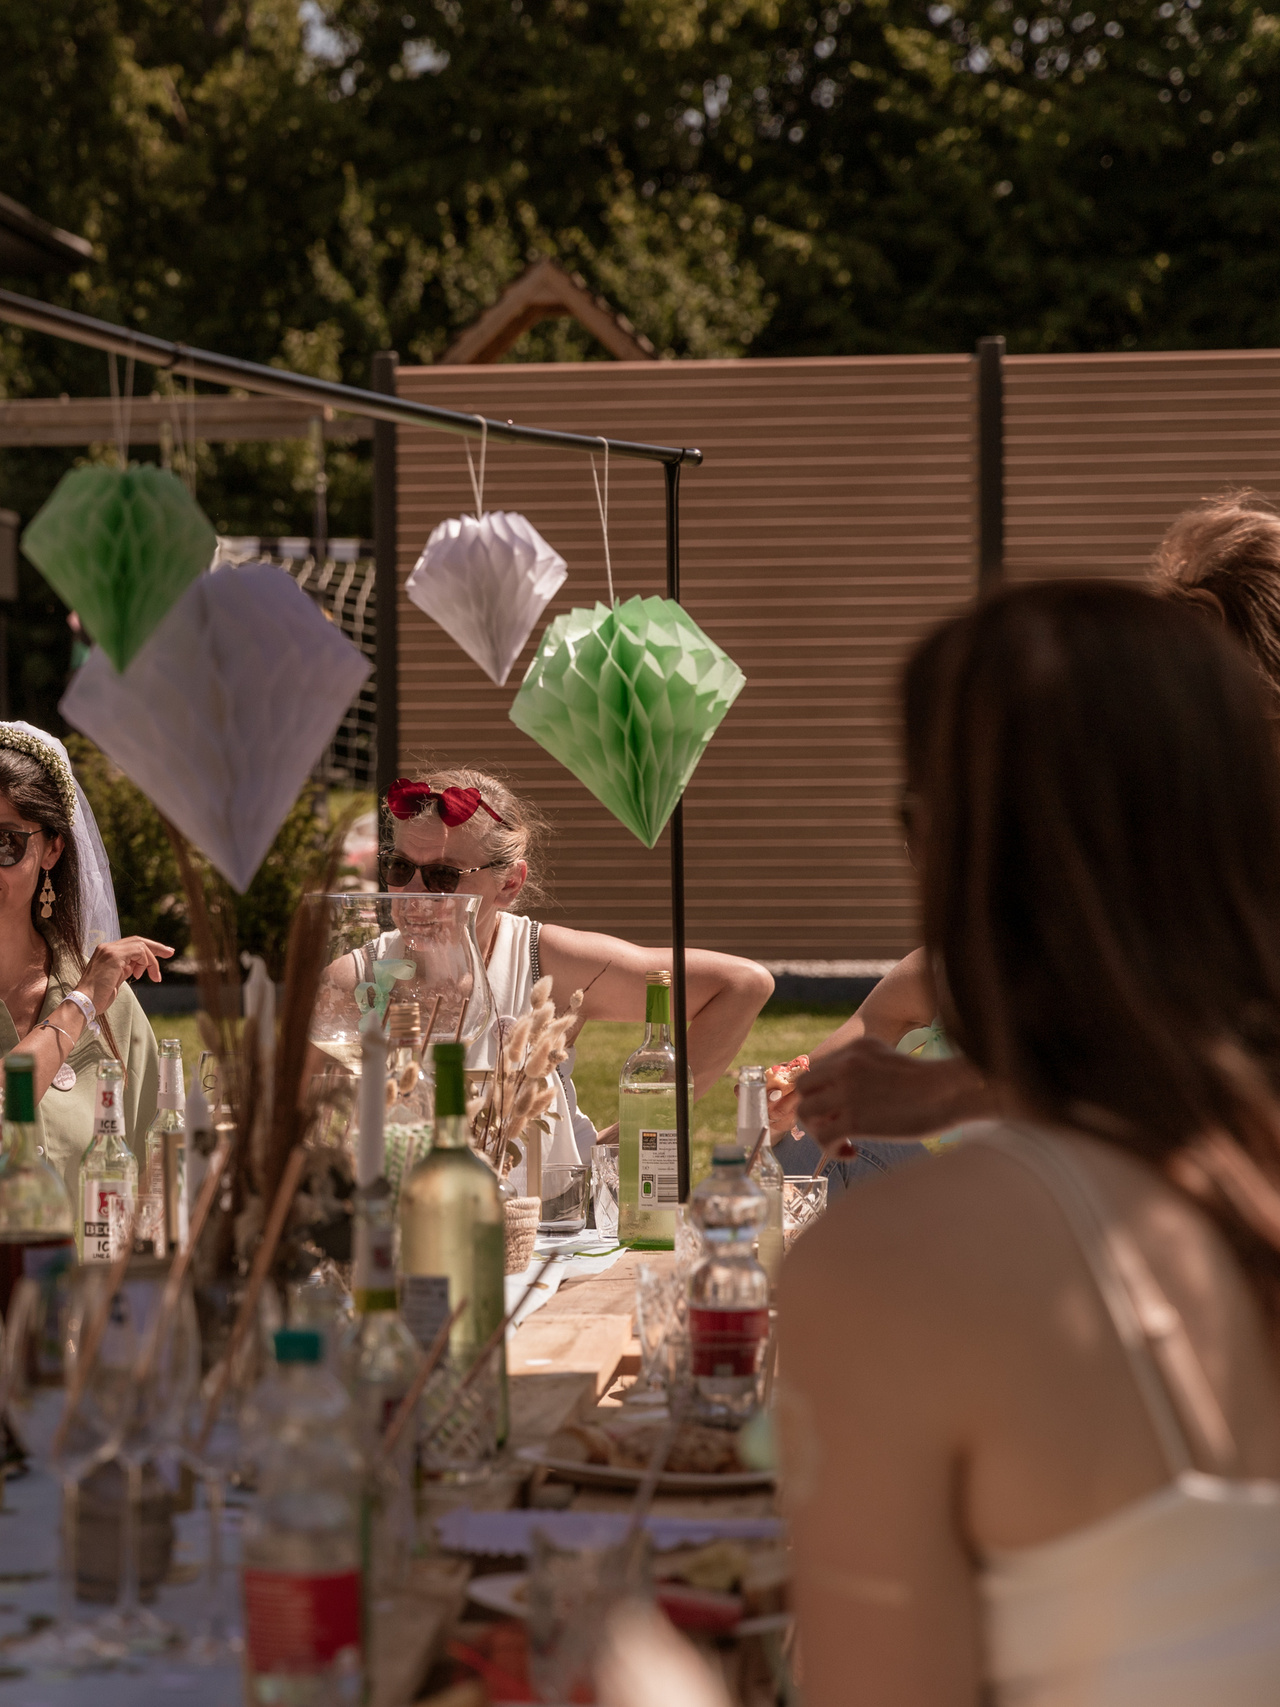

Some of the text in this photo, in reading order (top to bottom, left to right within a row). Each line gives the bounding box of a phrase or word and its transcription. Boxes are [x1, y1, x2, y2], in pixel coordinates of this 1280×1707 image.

[100, 1120, 117, 1129] ICE
[86, 1224, 110, 1235] BEC
[97, 1241, 110, 1252] IC
